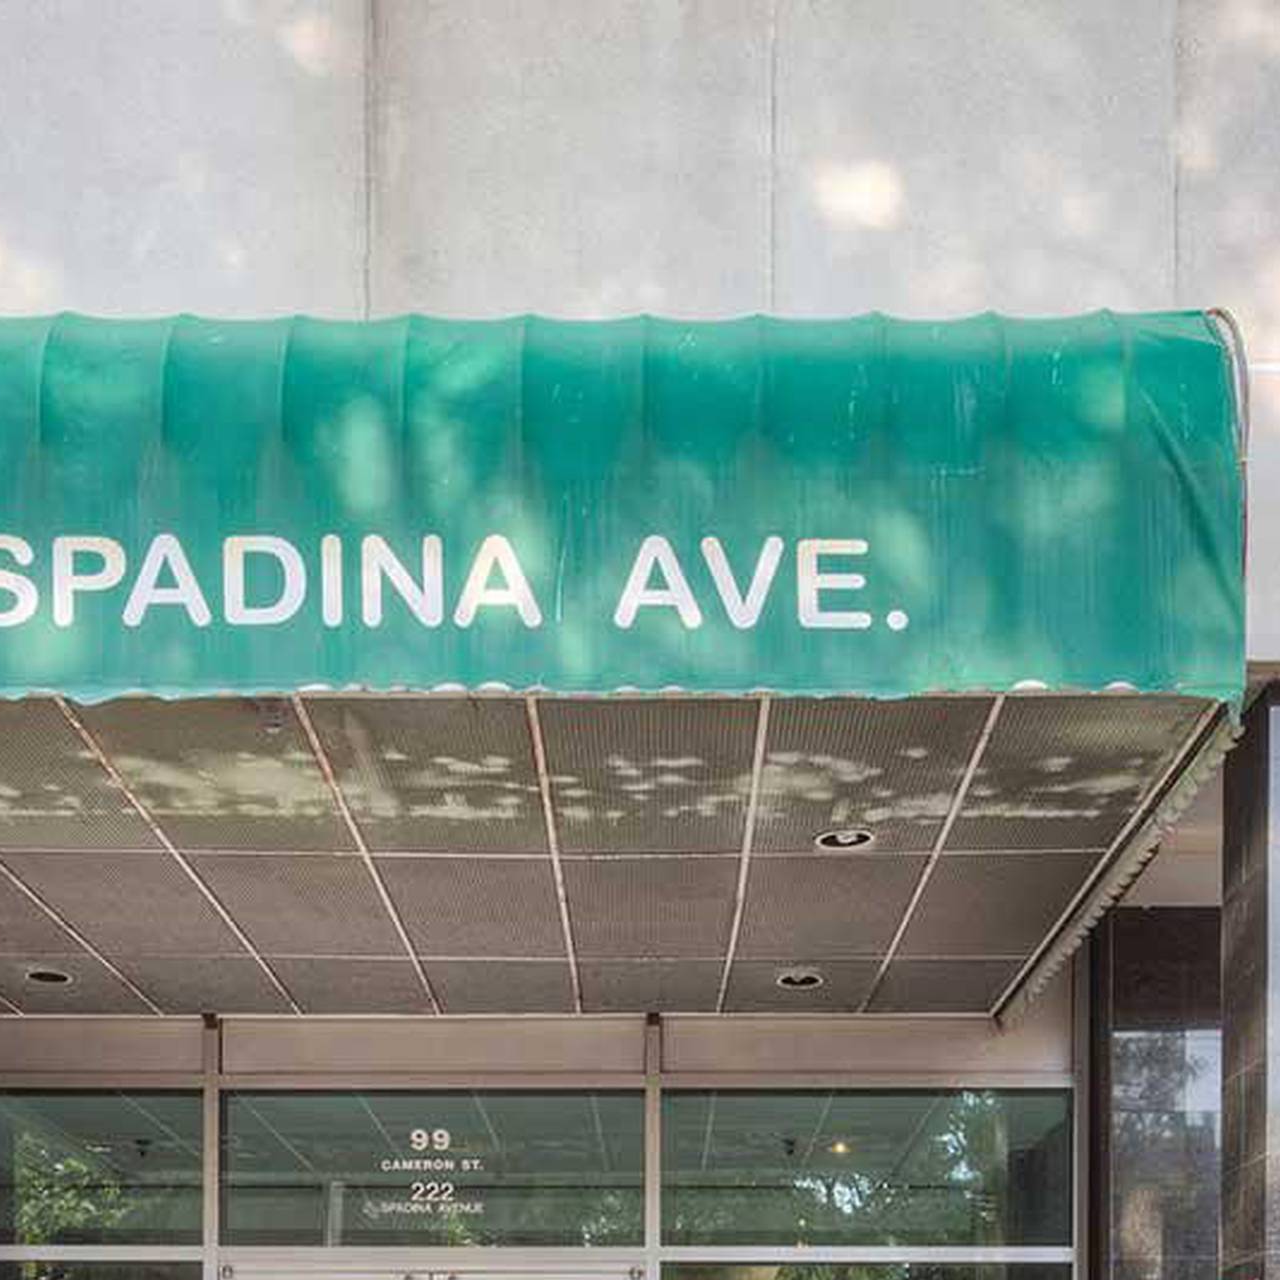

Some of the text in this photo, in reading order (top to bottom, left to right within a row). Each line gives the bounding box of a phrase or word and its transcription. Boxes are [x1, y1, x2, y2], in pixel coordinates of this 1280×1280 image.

[614, 534, 910, 630] AVE.
[410, 1128, 451, 1151] 99
[380, 1158, 485, 1172] CAMERON ST.
[411, 1182, 455, 1202] 222
